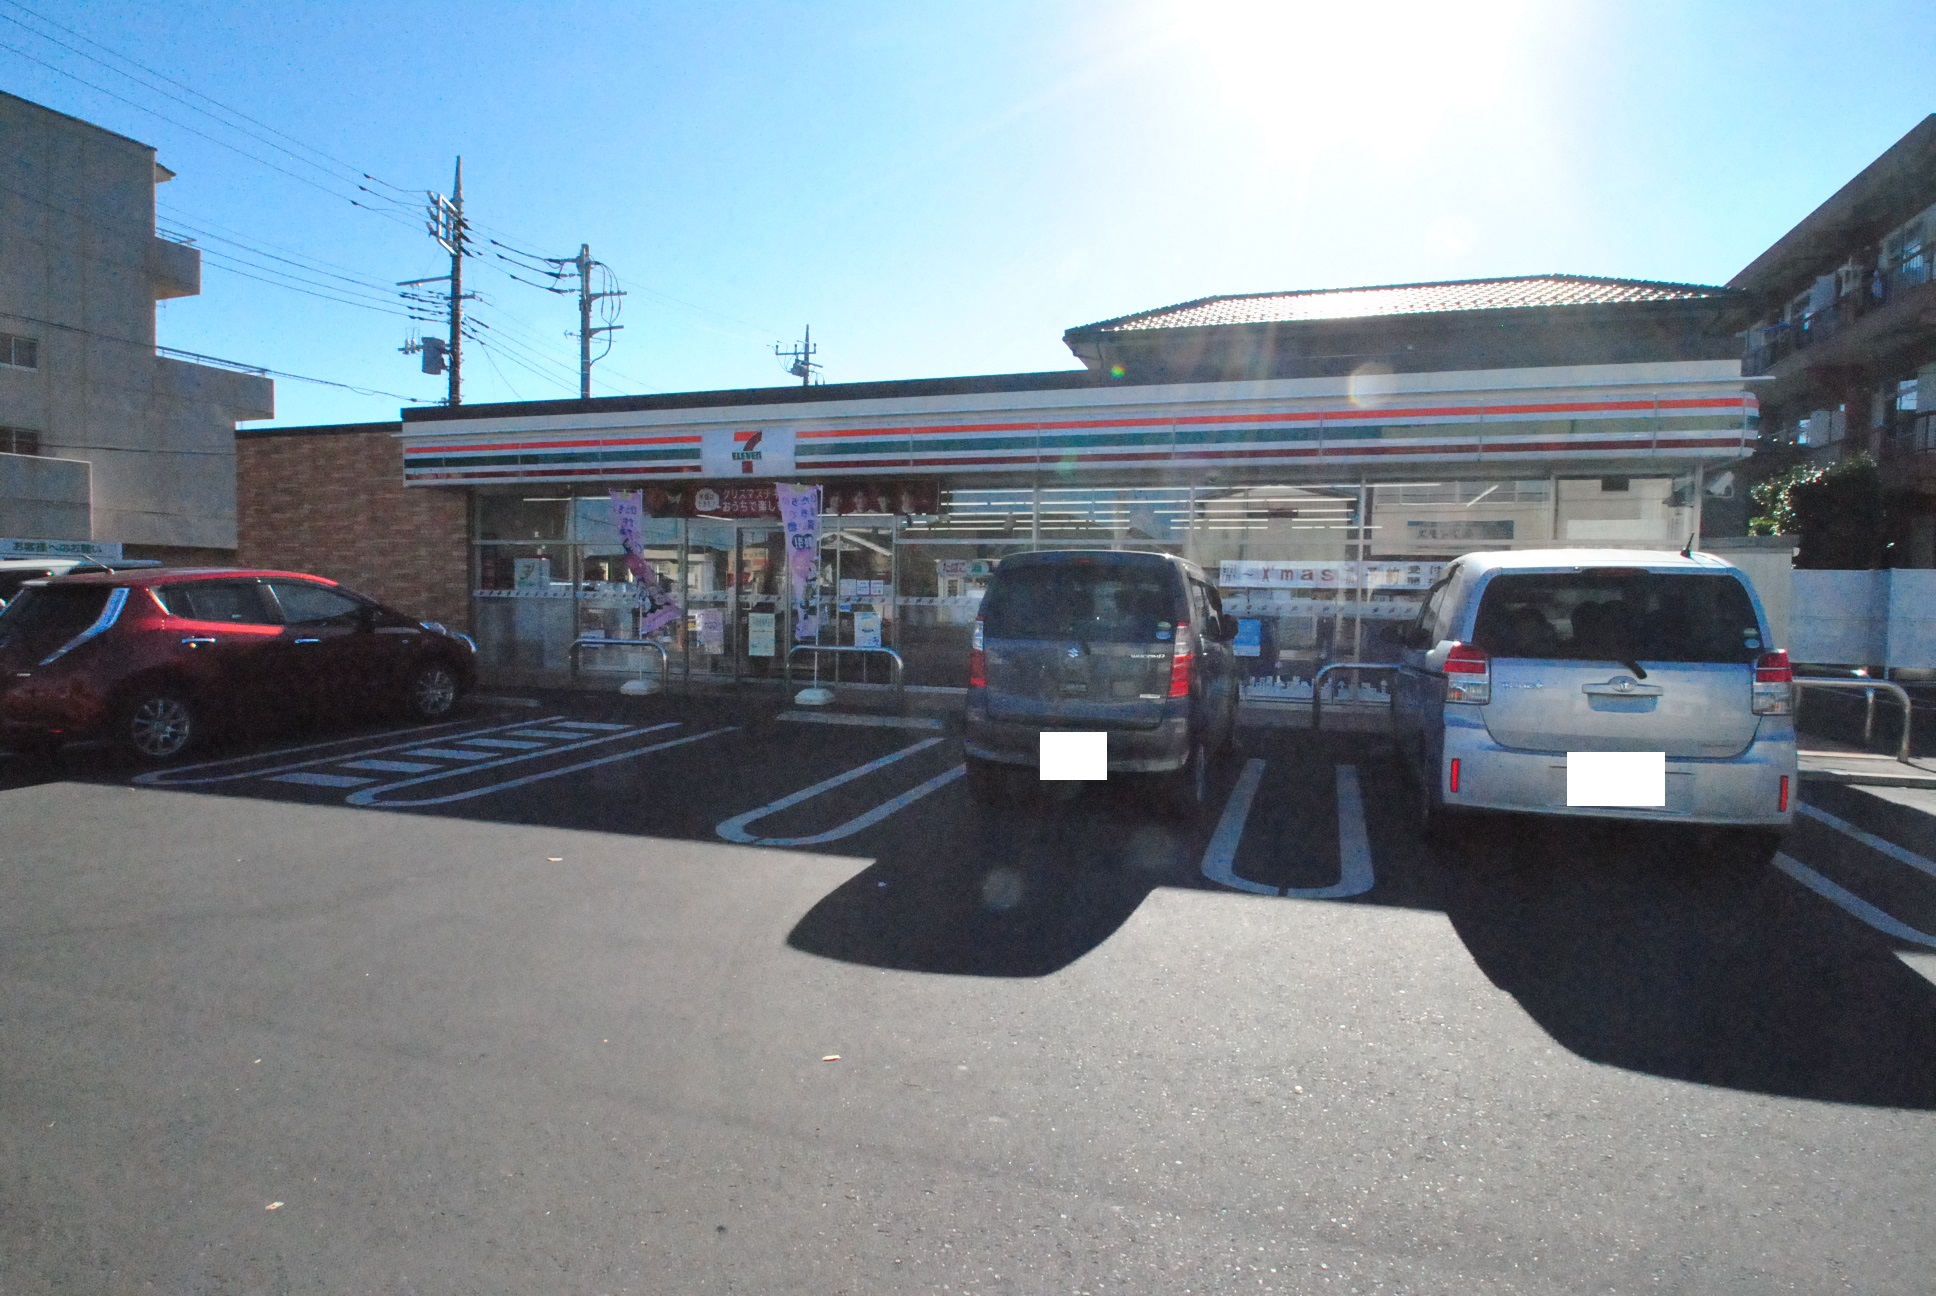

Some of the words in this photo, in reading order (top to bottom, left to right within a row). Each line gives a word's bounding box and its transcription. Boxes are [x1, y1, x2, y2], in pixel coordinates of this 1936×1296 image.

[734, 430, 762, 474] 7
[722, 500, 776, 511] おうちで楽し
